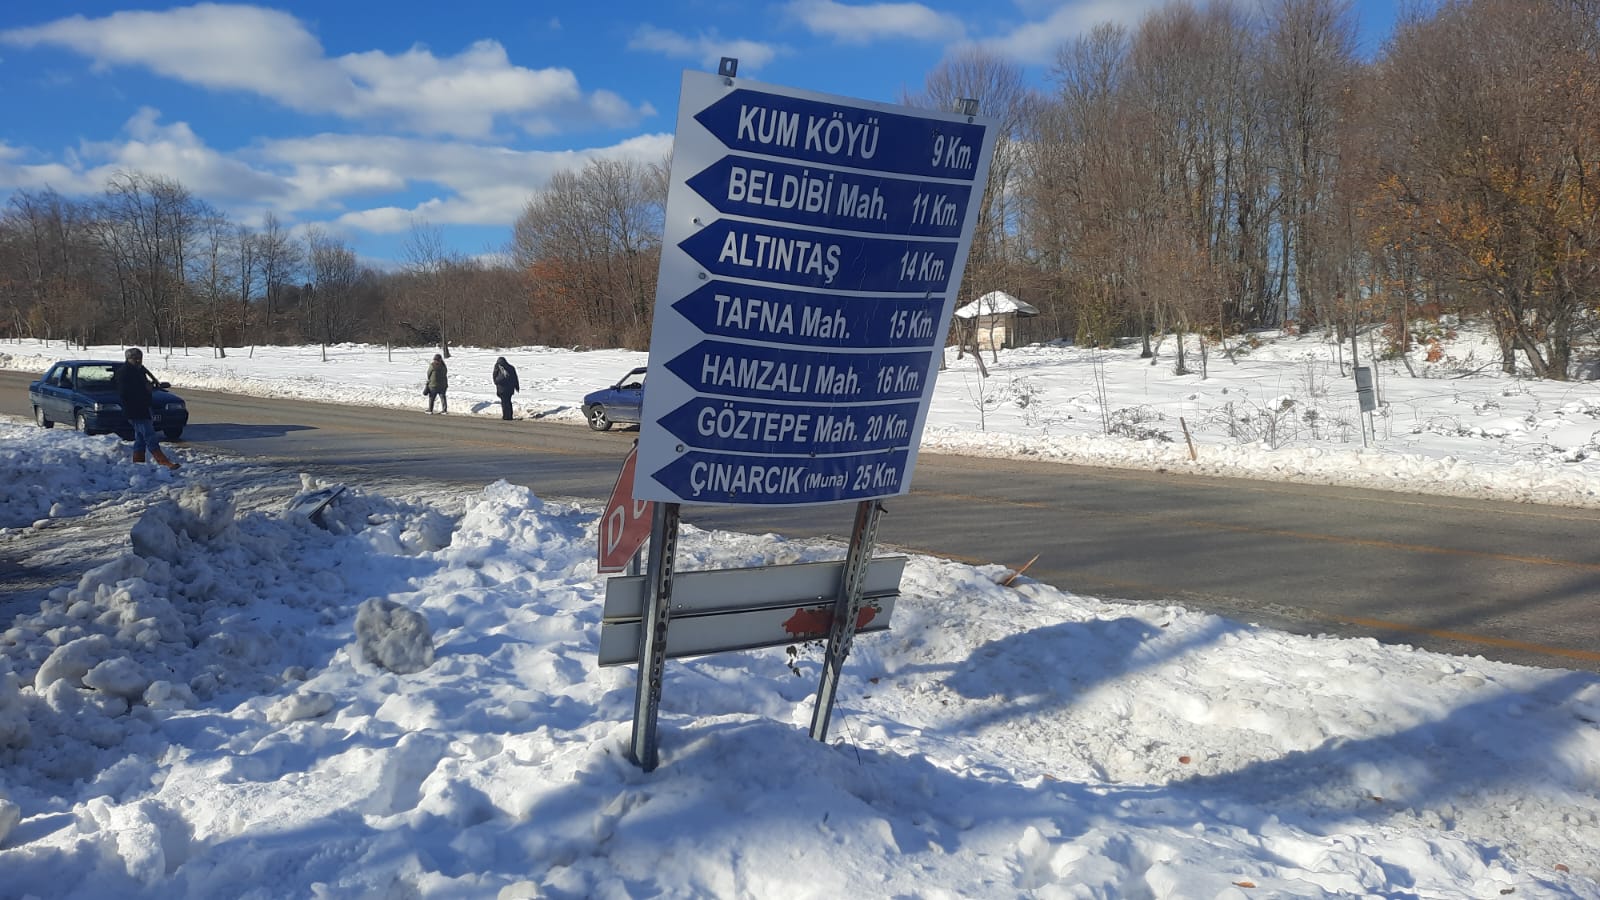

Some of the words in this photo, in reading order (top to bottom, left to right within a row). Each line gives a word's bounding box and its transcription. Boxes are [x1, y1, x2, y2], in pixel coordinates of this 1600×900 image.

[738, 105, 799, 147] KUM
[805, 111, 881, 158] KÖYÜ
[932, 135, 947, 167] 9
[945, 136, 971, 169] Km.
[728, 166, 834, 214] BELDİBİ
[837, 184, 887, 220] Mah.
[911, 193, 928, 223] 11
[930, 195, 957, 225] Km.
[718, 230, 842, 283] ALTINTAŞ
[900, 251, 918, 280] 14
[917, 252, 944, 281] Km.
[714, 295, 793, 337] TAFNA
[800, 306, 849, 341] Mah.
[890, 310, 907, 338] 15
[906, 311, 933, 338] Km.
[701, 354, 811, 395] HAMZALI
[815, 366, 860, 395] Mah.
[877, 366, 895, 393] 16
[894, 367, 919, 392] Km.
[698, 402, 812, 442] GÖZTEPE
[814, 415, 857, 442] Mah.
[864, 416, 884, 442] 20
[884, 414, 908, 439] Km.
[691, 462, 807, 496] ÇINARCIK
[804, 473, 848, 491] (Muna)
[853, 465, 872, 490] 25
[873, 463, 897, 488] Km.
